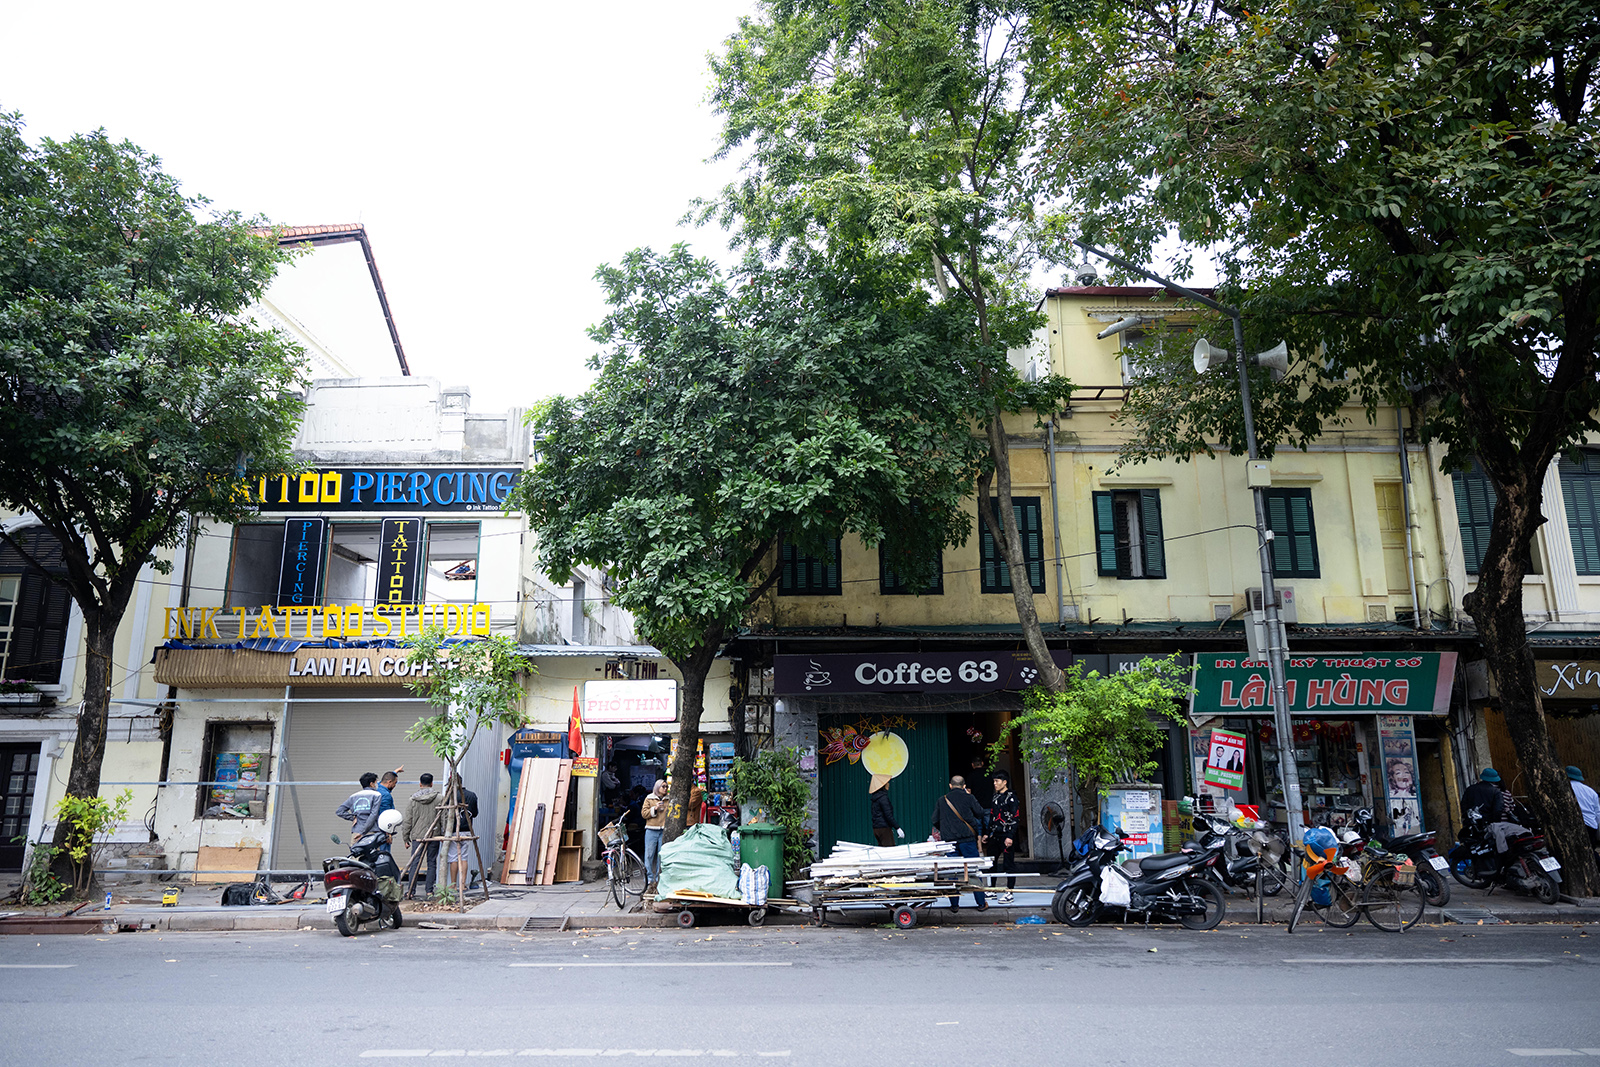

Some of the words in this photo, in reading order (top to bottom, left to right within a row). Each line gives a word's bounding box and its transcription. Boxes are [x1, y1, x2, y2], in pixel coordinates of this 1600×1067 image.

[350, 471, 516, 507] PIERCING
[291, 521, 312, 604] PIERCING
[389, 520, 410, 604] TATTOO
[162, 606, 222, 640] INK
[232, 603, 364, 639] TATTOO
[372, 602, 492, 637] STUDIO
[288, 657, 337, 677] LAN
[341, 657, 372, 677] HA
[854, 662, 952, 685] Coffee
[957, 660, 998, 683] 63
[1214, 659, 1236, 669] IN
[1394, 656, 1424, 668] SỐ
[623, 694, 670, 711] THÌN
[1306, 673, 1409, 710] HÙNG
